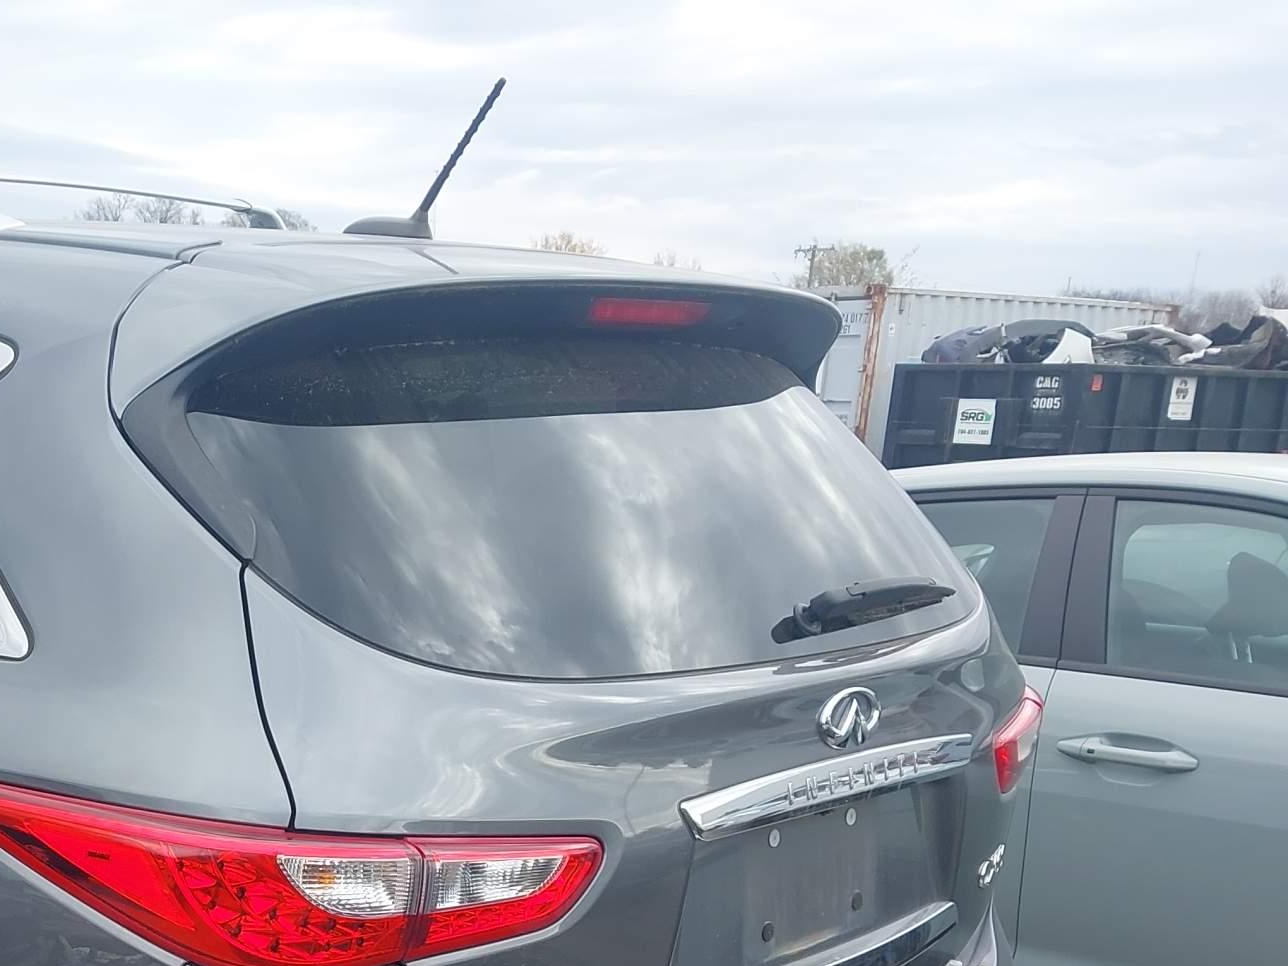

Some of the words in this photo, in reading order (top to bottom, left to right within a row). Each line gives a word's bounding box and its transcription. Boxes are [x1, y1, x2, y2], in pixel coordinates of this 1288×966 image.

[1032, 397, 1061, 409] 3085
[960, 411, 985, 421] SRG
[787, 751, 919, 806] INFINITI
